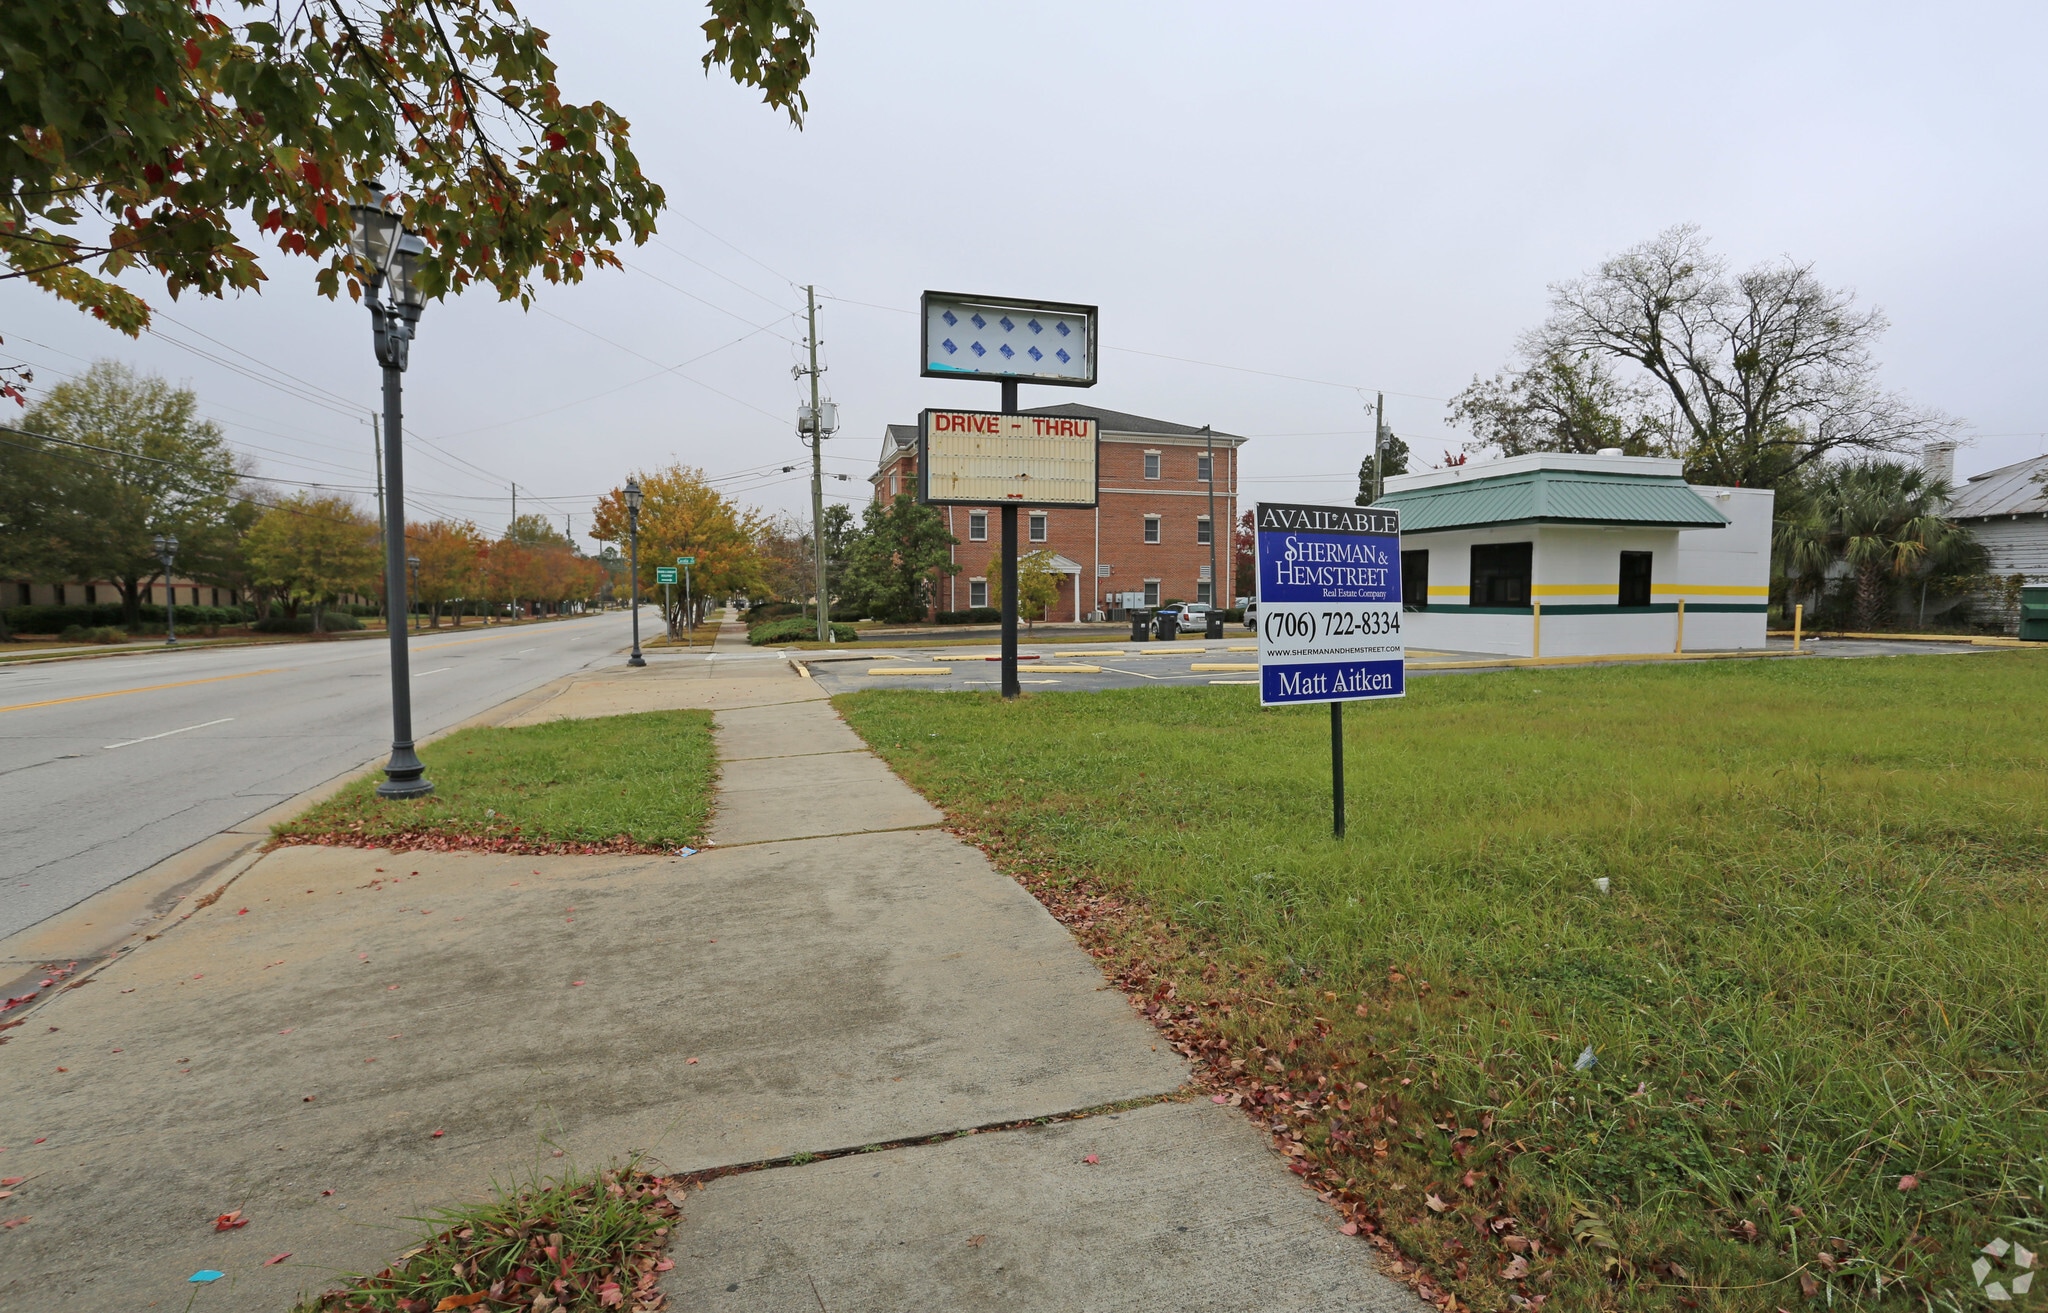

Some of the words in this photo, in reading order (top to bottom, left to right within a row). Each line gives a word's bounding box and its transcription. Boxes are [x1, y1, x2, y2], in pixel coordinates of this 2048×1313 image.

[935, 414, 999, 433] DRIVE
[1033, 419, 1088, 437] THRU
[1259, 508, 1398, 534] AVAILABLE
[1284, 536, 1376, 564] SHERMAN
[1378, 551, 1388, 565] &
[1275, 560, 1388, 587] HEMSTREET
[1323, 588, 1337, 598] Real
[1338, 588, 1357, 598] Estate
[1358, 589, 1387, 600] Company
[1264, 611, 1317, 644] (706)
[1321, 611, 1400, 636] 722-8334
[1267, 645, 1400, 657] WWW.SHERMANANDHEMSTREET.COM
[1278, 671, 1327, 696] Matt
[1332, 667, 1393, 693] Aitken
